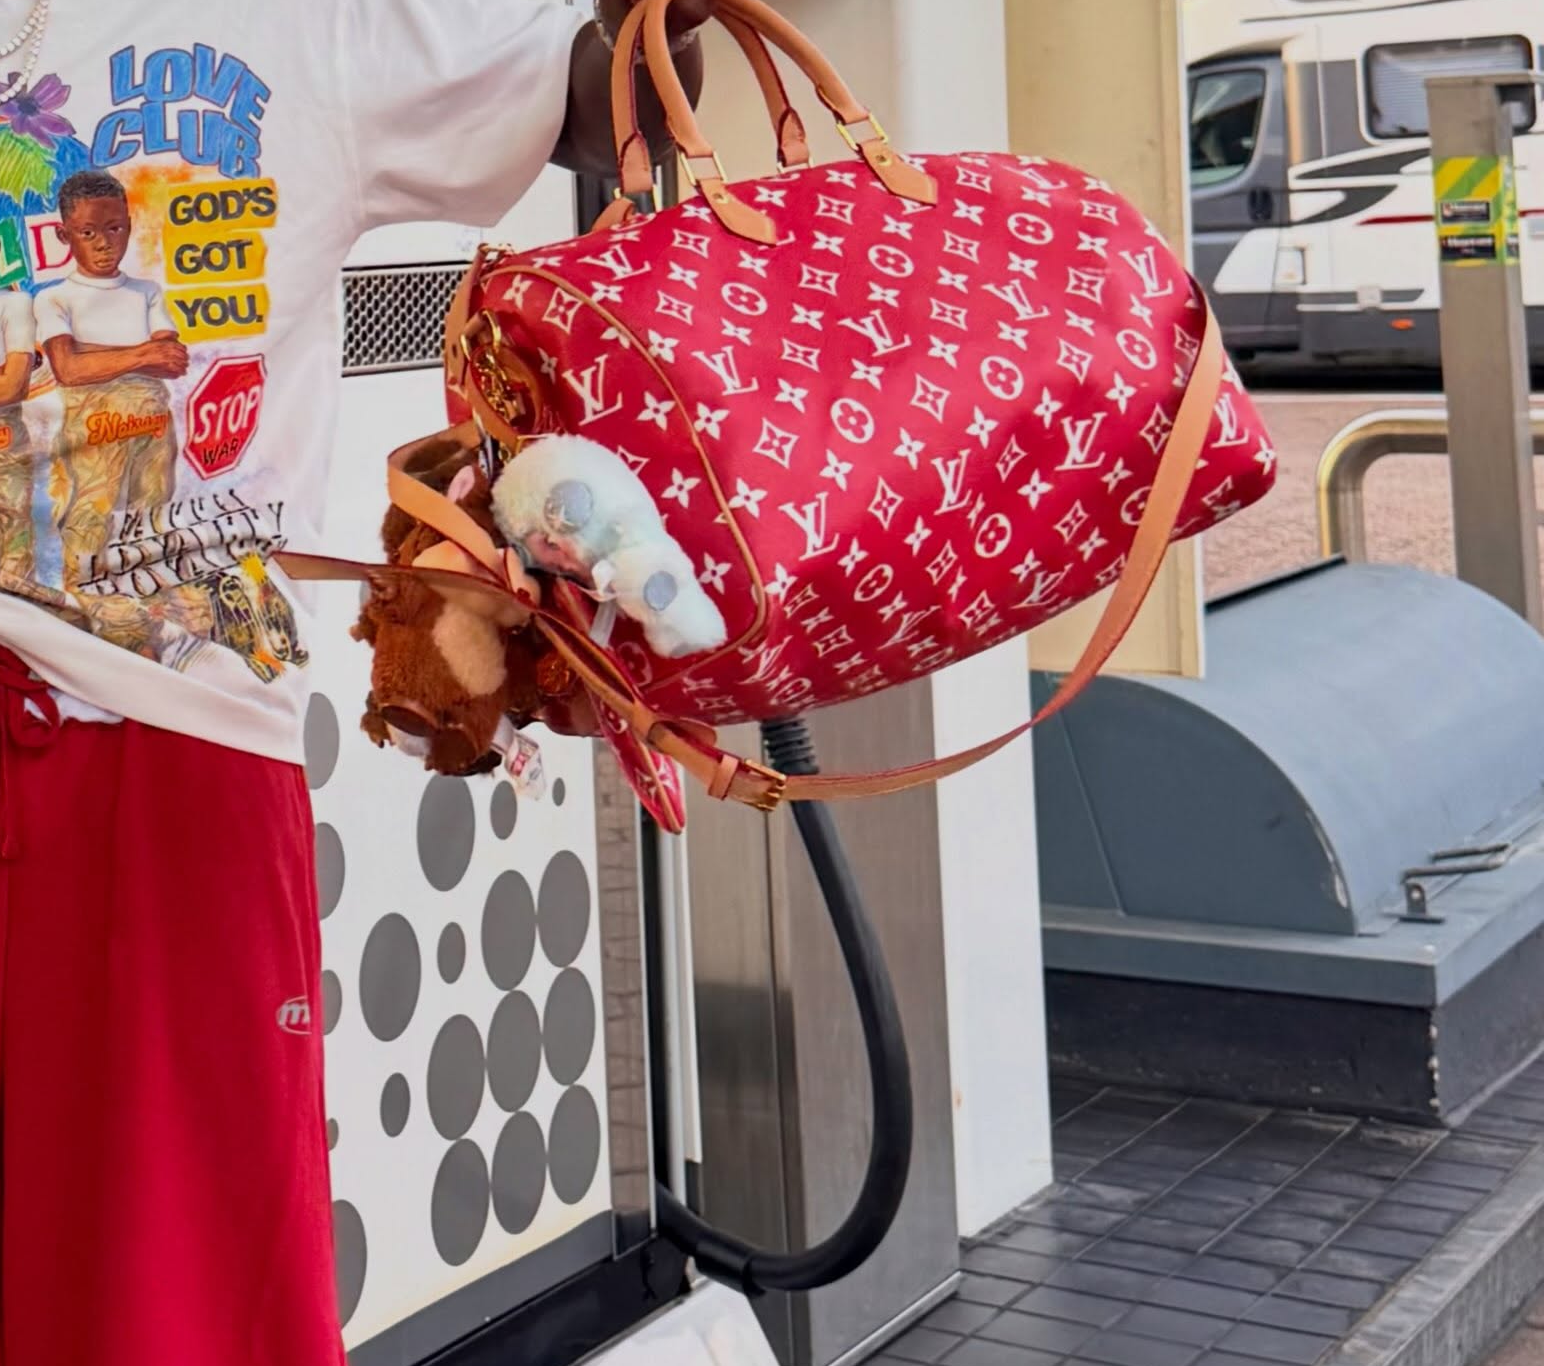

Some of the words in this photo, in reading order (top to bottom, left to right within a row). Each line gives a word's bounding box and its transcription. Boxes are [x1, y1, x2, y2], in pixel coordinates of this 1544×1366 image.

[109, 42, 272, 136] LOVE
[90, 101, 262, 181] CLUB
[168, 186, 277, 226] GOD'S
[173, 239, 253, 275] GOT
[194, 384, 260, 444] STOP
